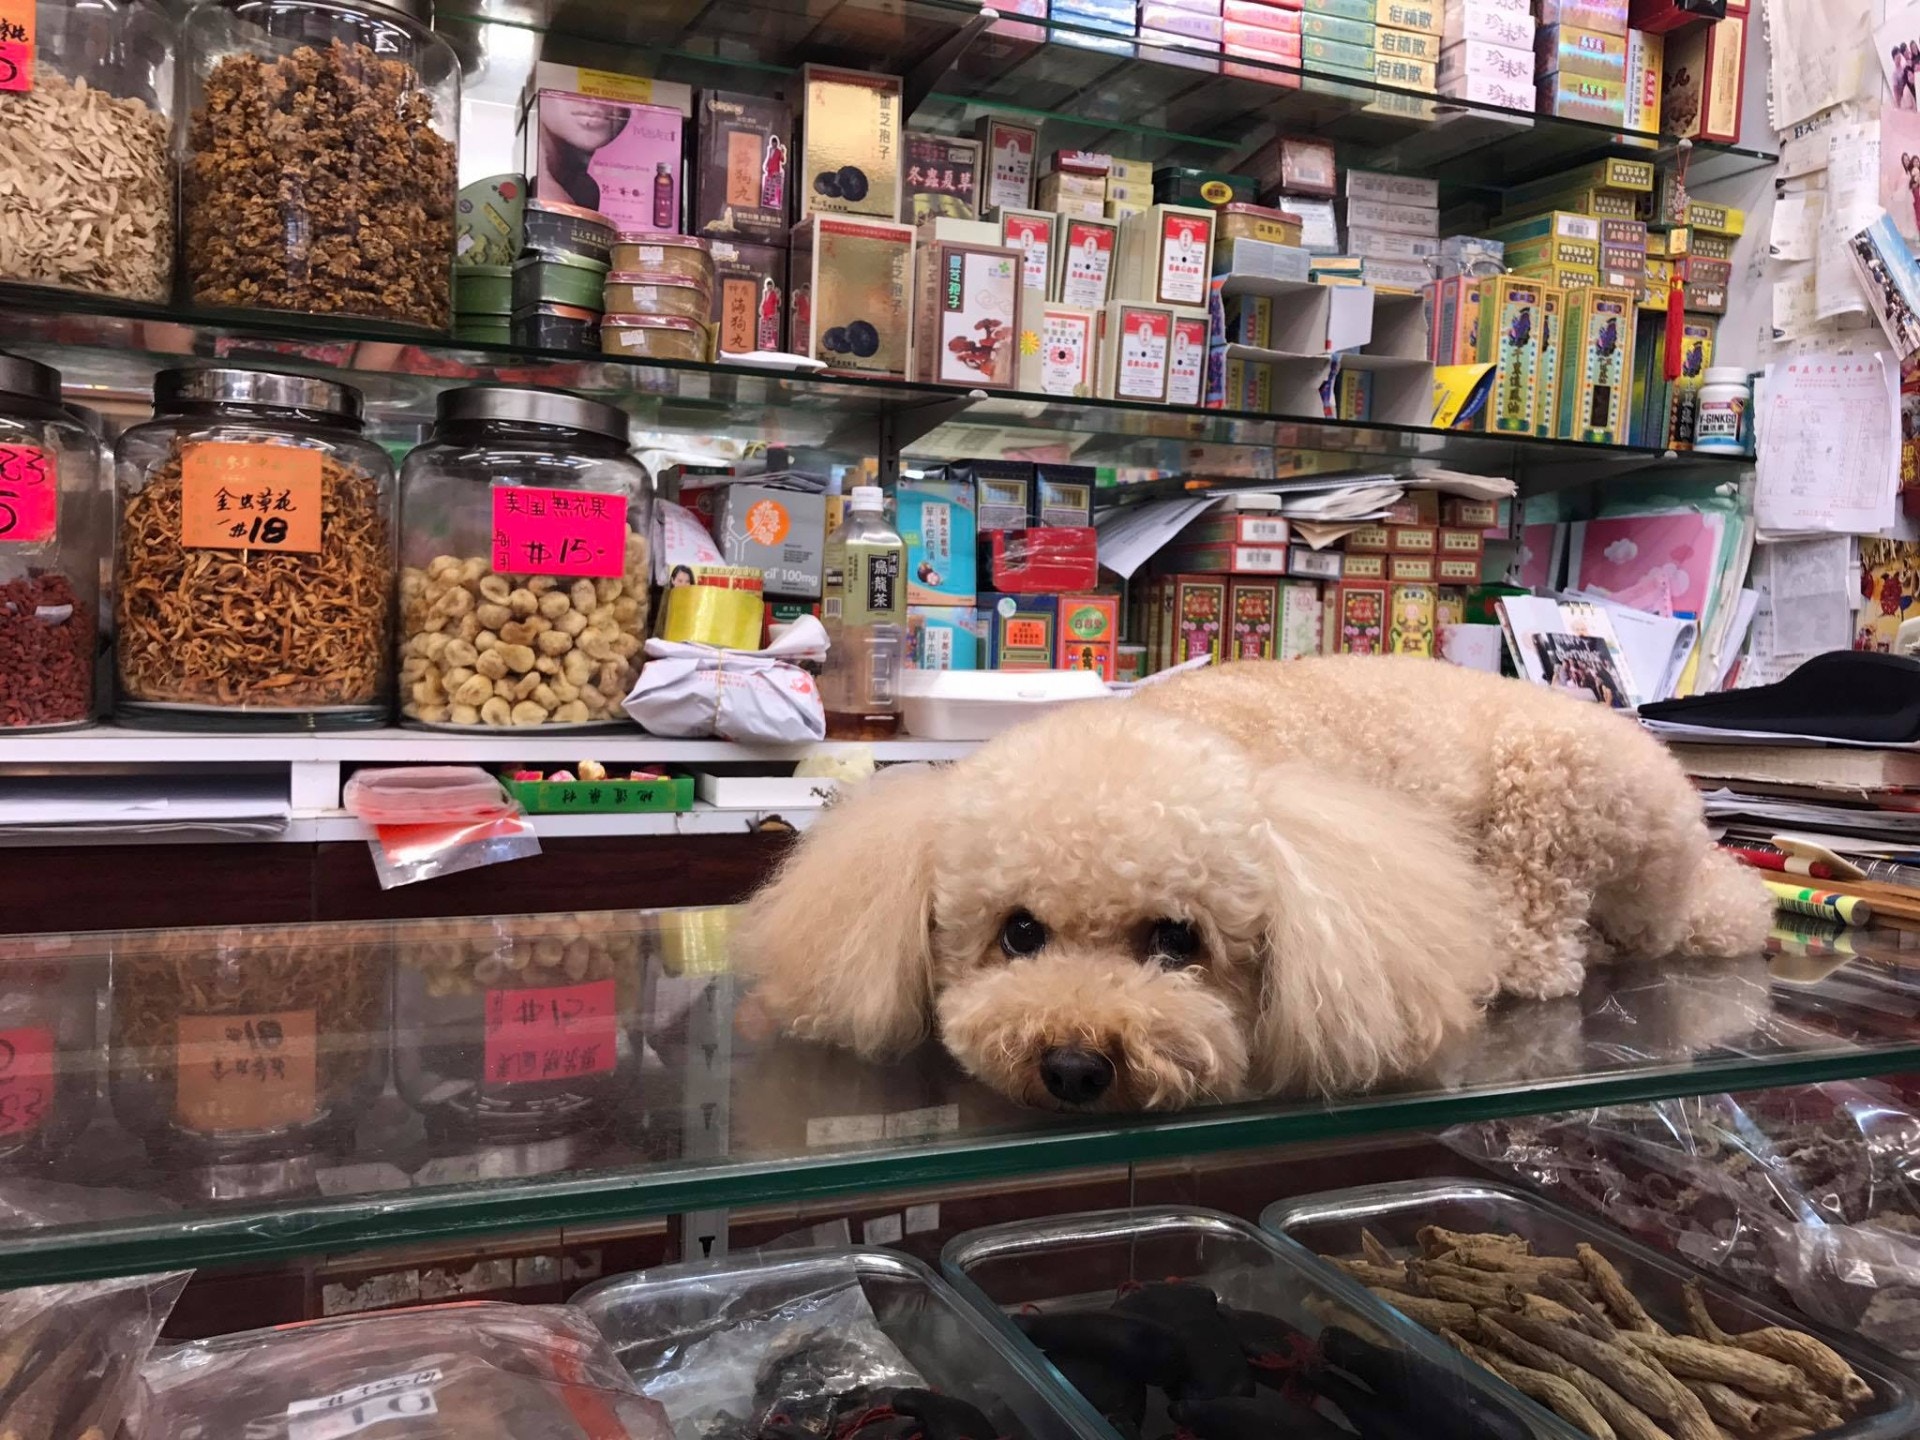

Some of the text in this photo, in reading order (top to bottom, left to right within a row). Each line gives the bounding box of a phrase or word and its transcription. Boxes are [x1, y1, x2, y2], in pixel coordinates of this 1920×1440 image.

[1485, 14, 1528, 42] 珍珠末
[1378, 61, 1421, 85] 疳積散
[1486, 50, 1528, 78] 珍珠末
[907, 165, 973, 192] 冬蟲夏草
[214, 487, 297, 513] 金虫草花
[782, 569, 818, 586] 100mg
[874, 560, 888, 607] 烏龍茶
